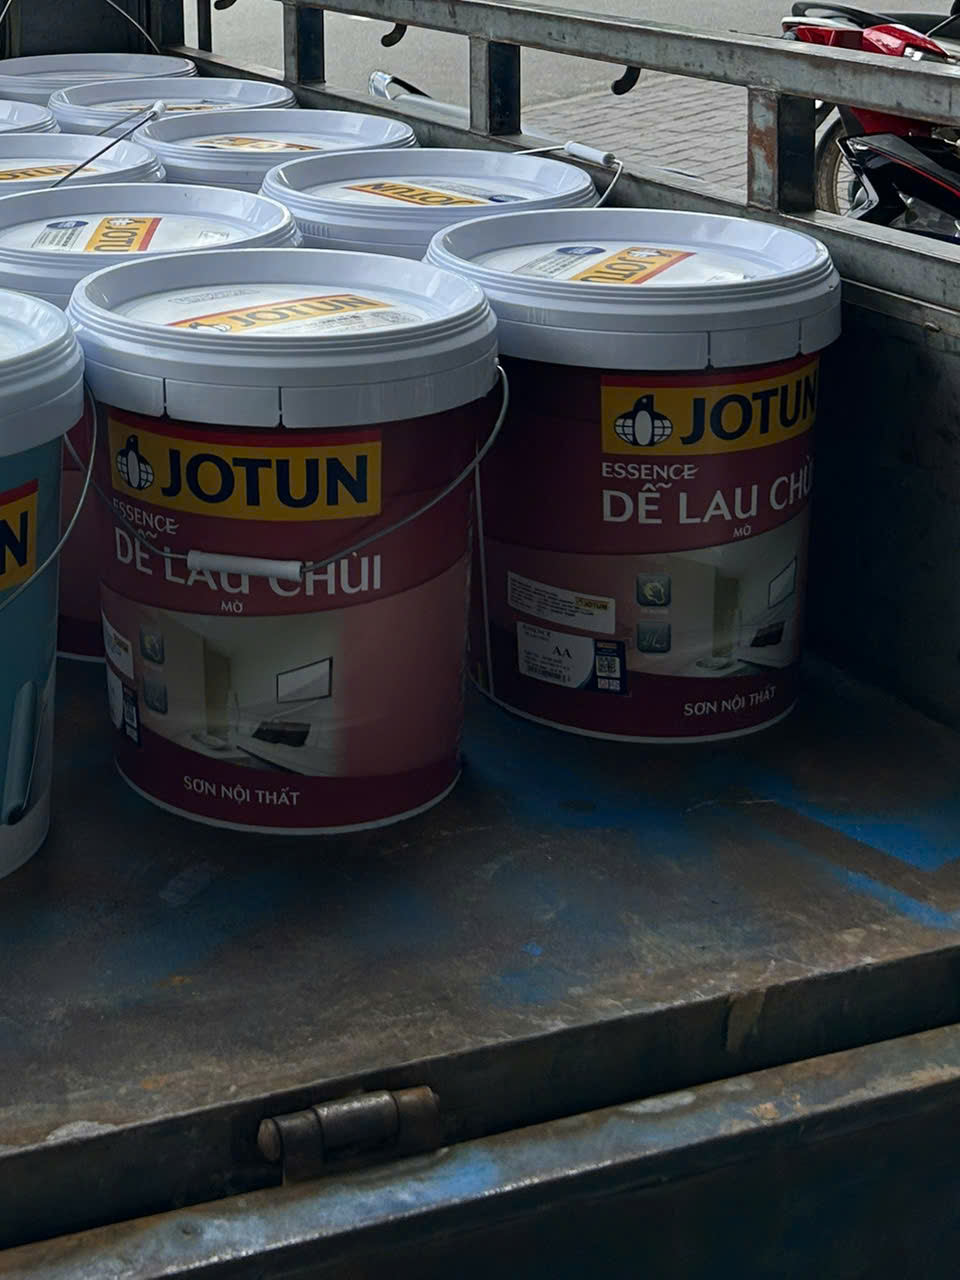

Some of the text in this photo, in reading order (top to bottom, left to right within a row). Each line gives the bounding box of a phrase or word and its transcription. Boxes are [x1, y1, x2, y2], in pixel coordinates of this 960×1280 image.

[94, 226, 141, 252] JOTU
[580, 255, 657, 284] JOTU
[229, 296, 380, 328] JOTUN
[681, 374, 817, 445] JOTUN
[162, 447, 369, 507] JOTUN
[602, 461, 700, 480] ESSENCE
[602, 456, 816, 524] DỄ LAU CHÙ
[112, 497, 180, 535] ESSENCE
[732, 523, 752, 538] MỜ
[114, 526, 158, 576] DỄ
[221, 599, 244, 613] MỜ
[684, 686, 776, 716] SƠN NỘI THẤT
[184, 775, 300, 806] SƠN NỘI THẤT
